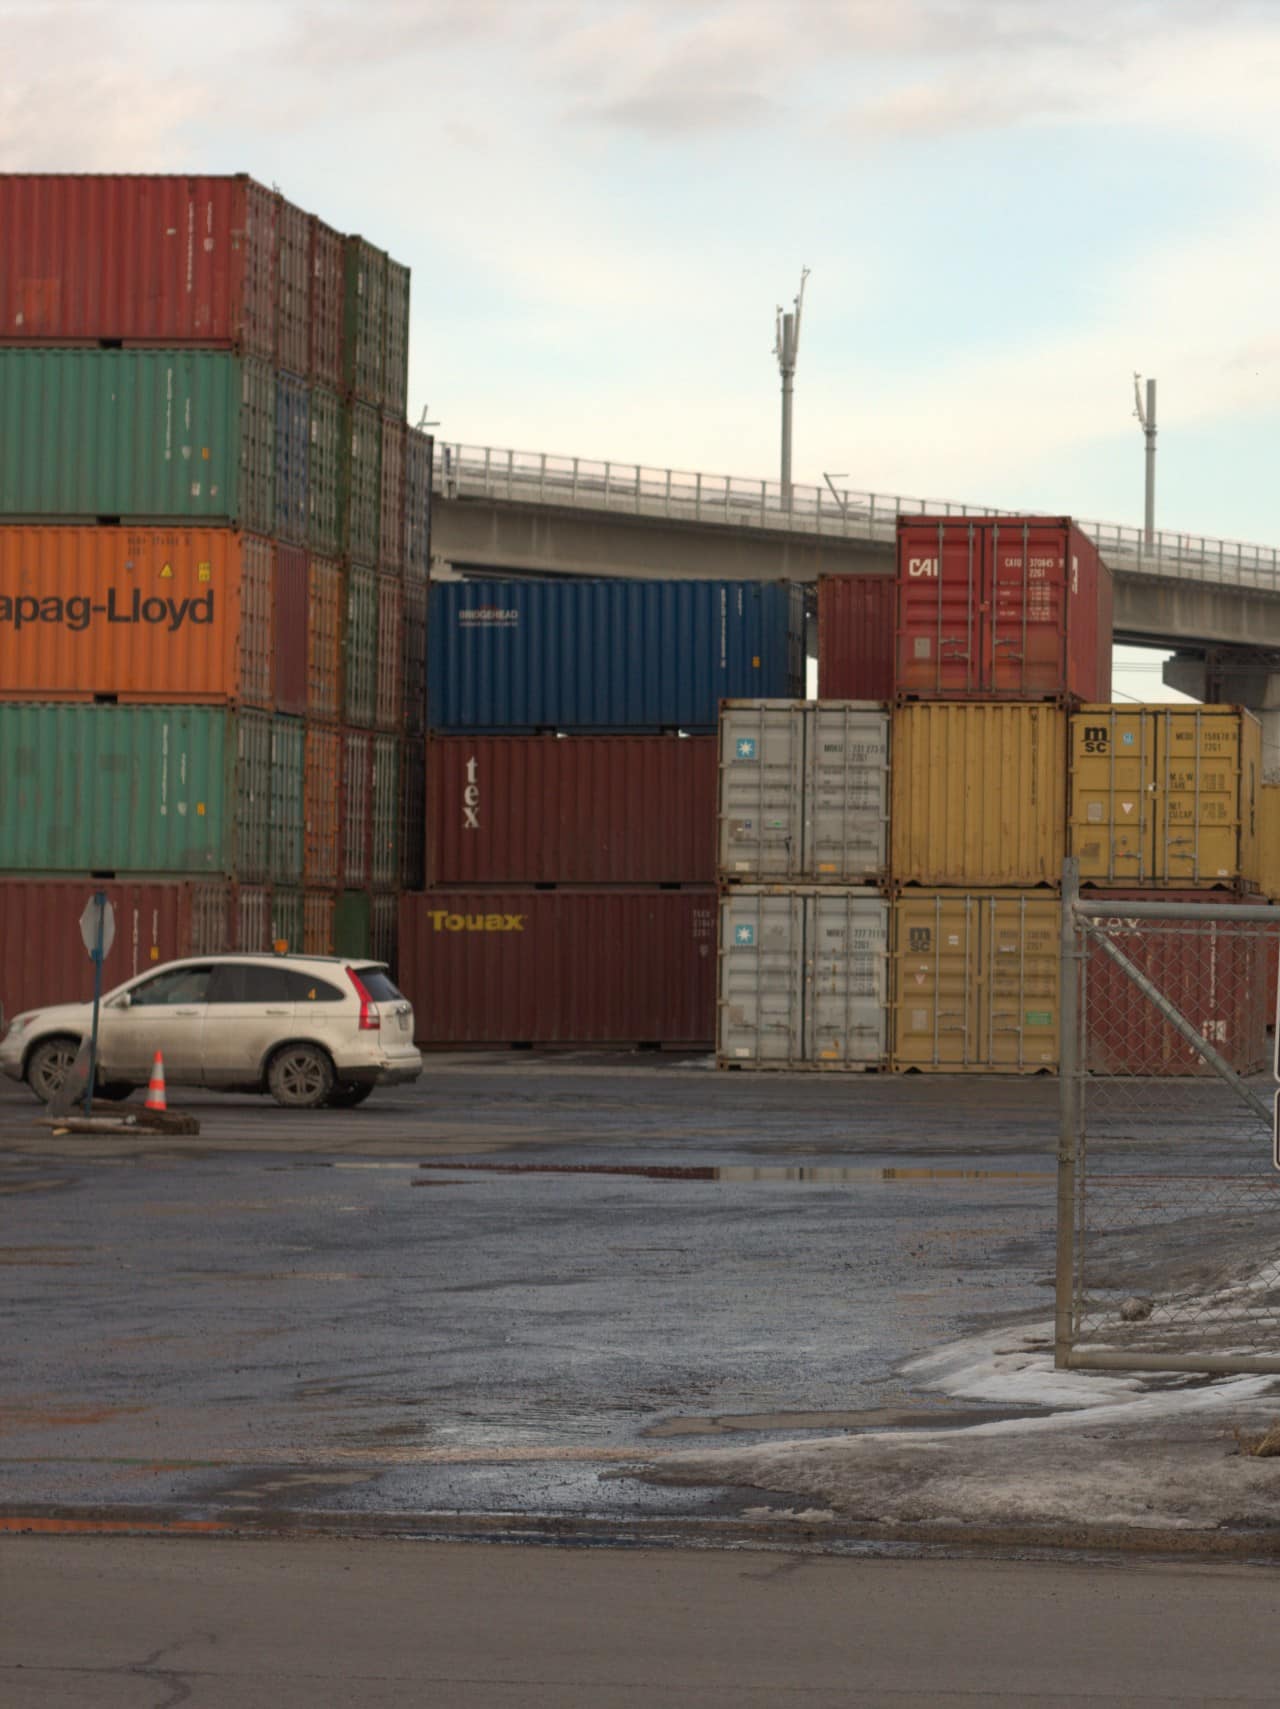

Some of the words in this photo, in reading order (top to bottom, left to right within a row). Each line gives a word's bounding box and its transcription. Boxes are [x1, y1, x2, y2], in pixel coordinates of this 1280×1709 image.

[909, 558, 938, 577] CAI
[463, 756, 481, 829] tex
[429, 909, 525, 931] Touax
[308, 988, 316, 1000] 4
